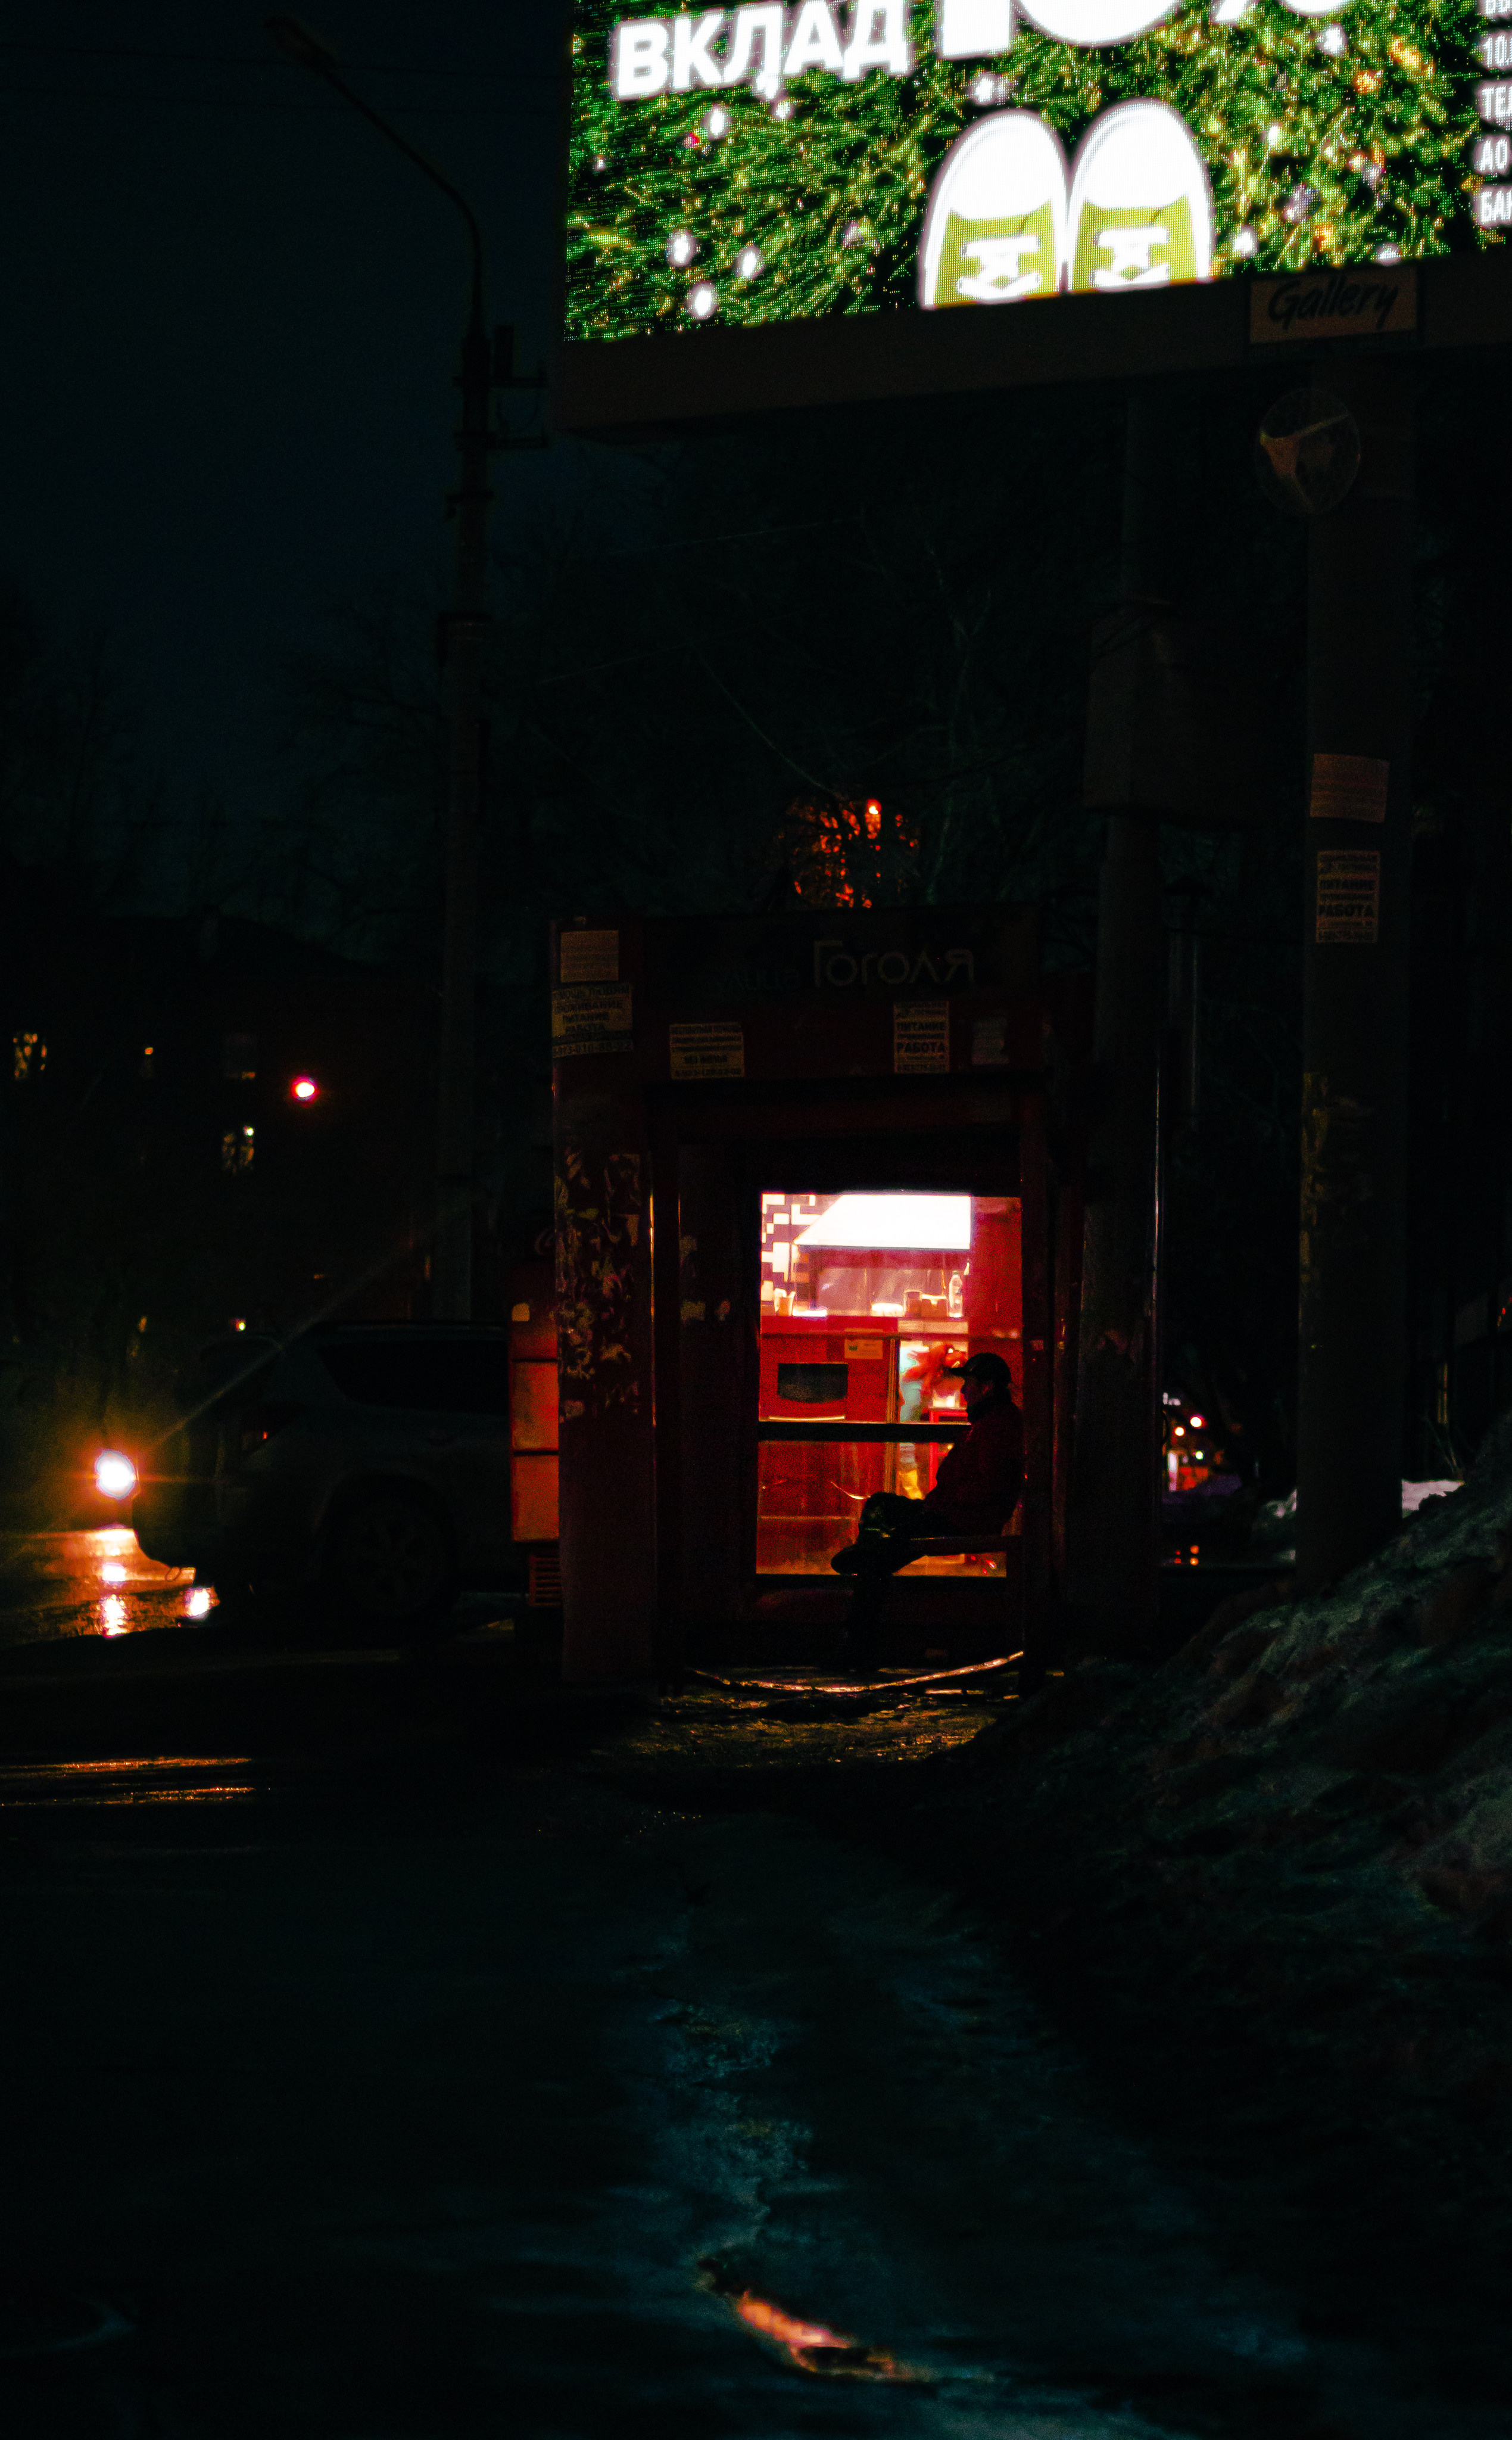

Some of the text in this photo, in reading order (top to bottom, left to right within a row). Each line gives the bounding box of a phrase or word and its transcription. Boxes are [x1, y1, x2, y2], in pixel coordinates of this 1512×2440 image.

[616, 0, 906, 98] ВКЛАД
[1481, 85, 1512, 119] ТЕ
[1480, 189, 1512, 223] БА
[1268, 276, 1398, 331] Gallery
[1318, 904, 1374, 917] РАБОТА
[813, 939, 975, 988] Гоголя
[897, 1042, 945, 1053] РАБОТА
